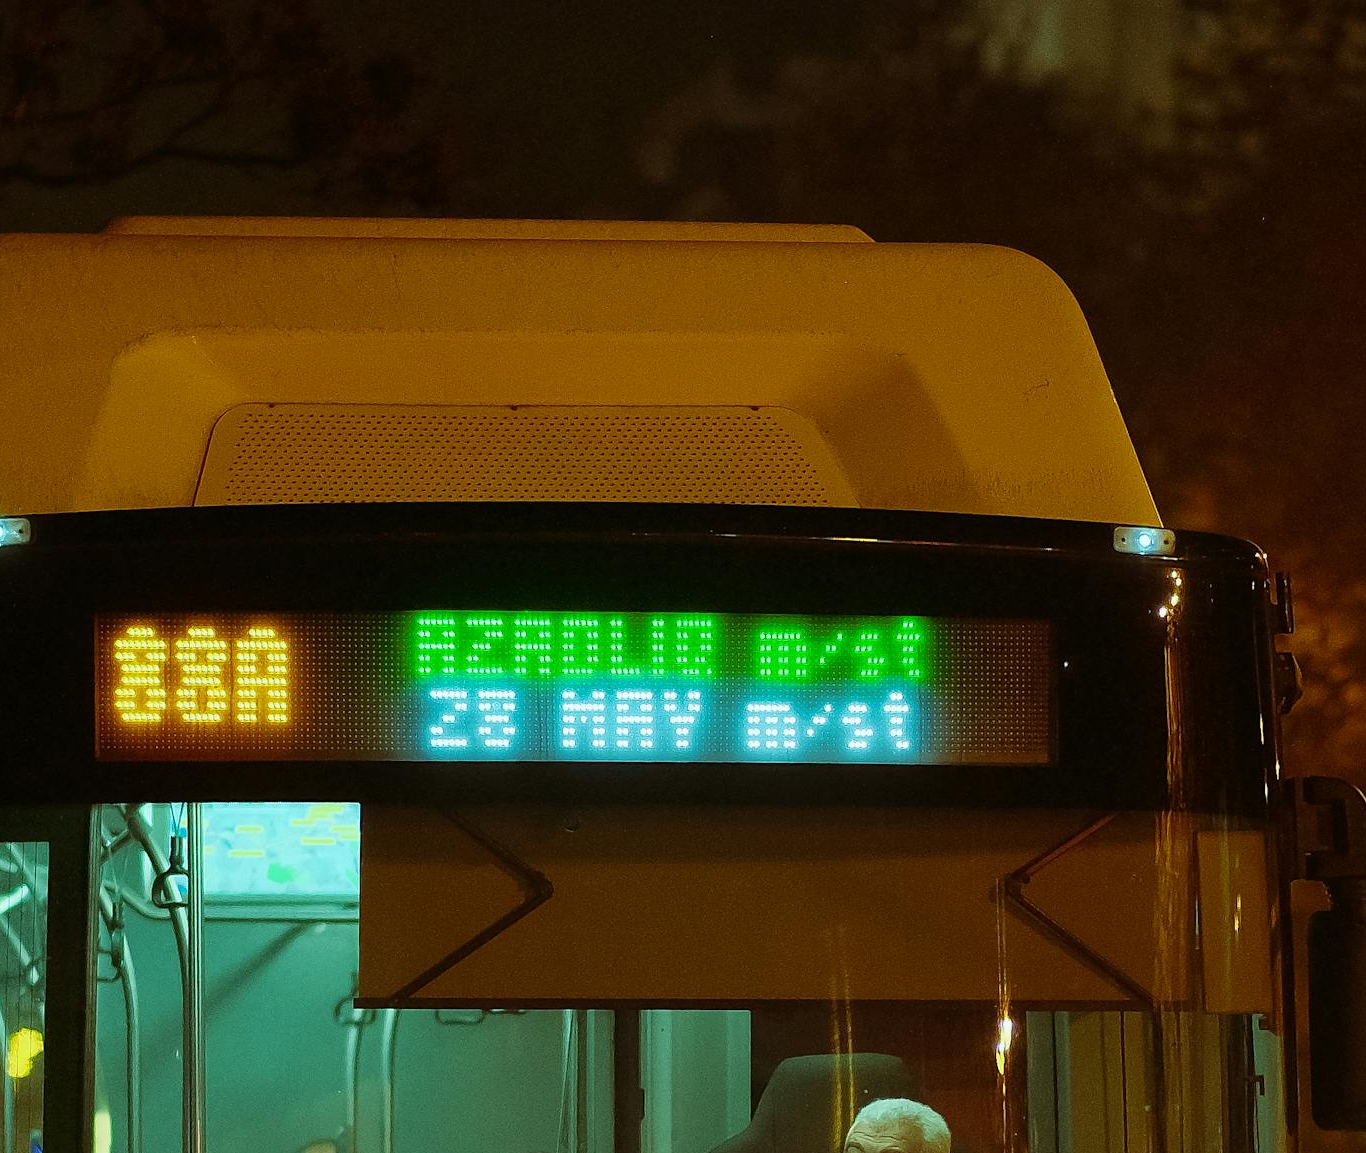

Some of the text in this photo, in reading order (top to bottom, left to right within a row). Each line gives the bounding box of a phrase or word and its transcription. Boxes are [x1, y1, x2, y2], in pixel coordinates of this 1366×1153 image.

[114, 626, 288, 723] 88A
[418, 617, 921, 676] AZADLIQ m/st
[429, 690, 910, 749] 28 MAY m/st
